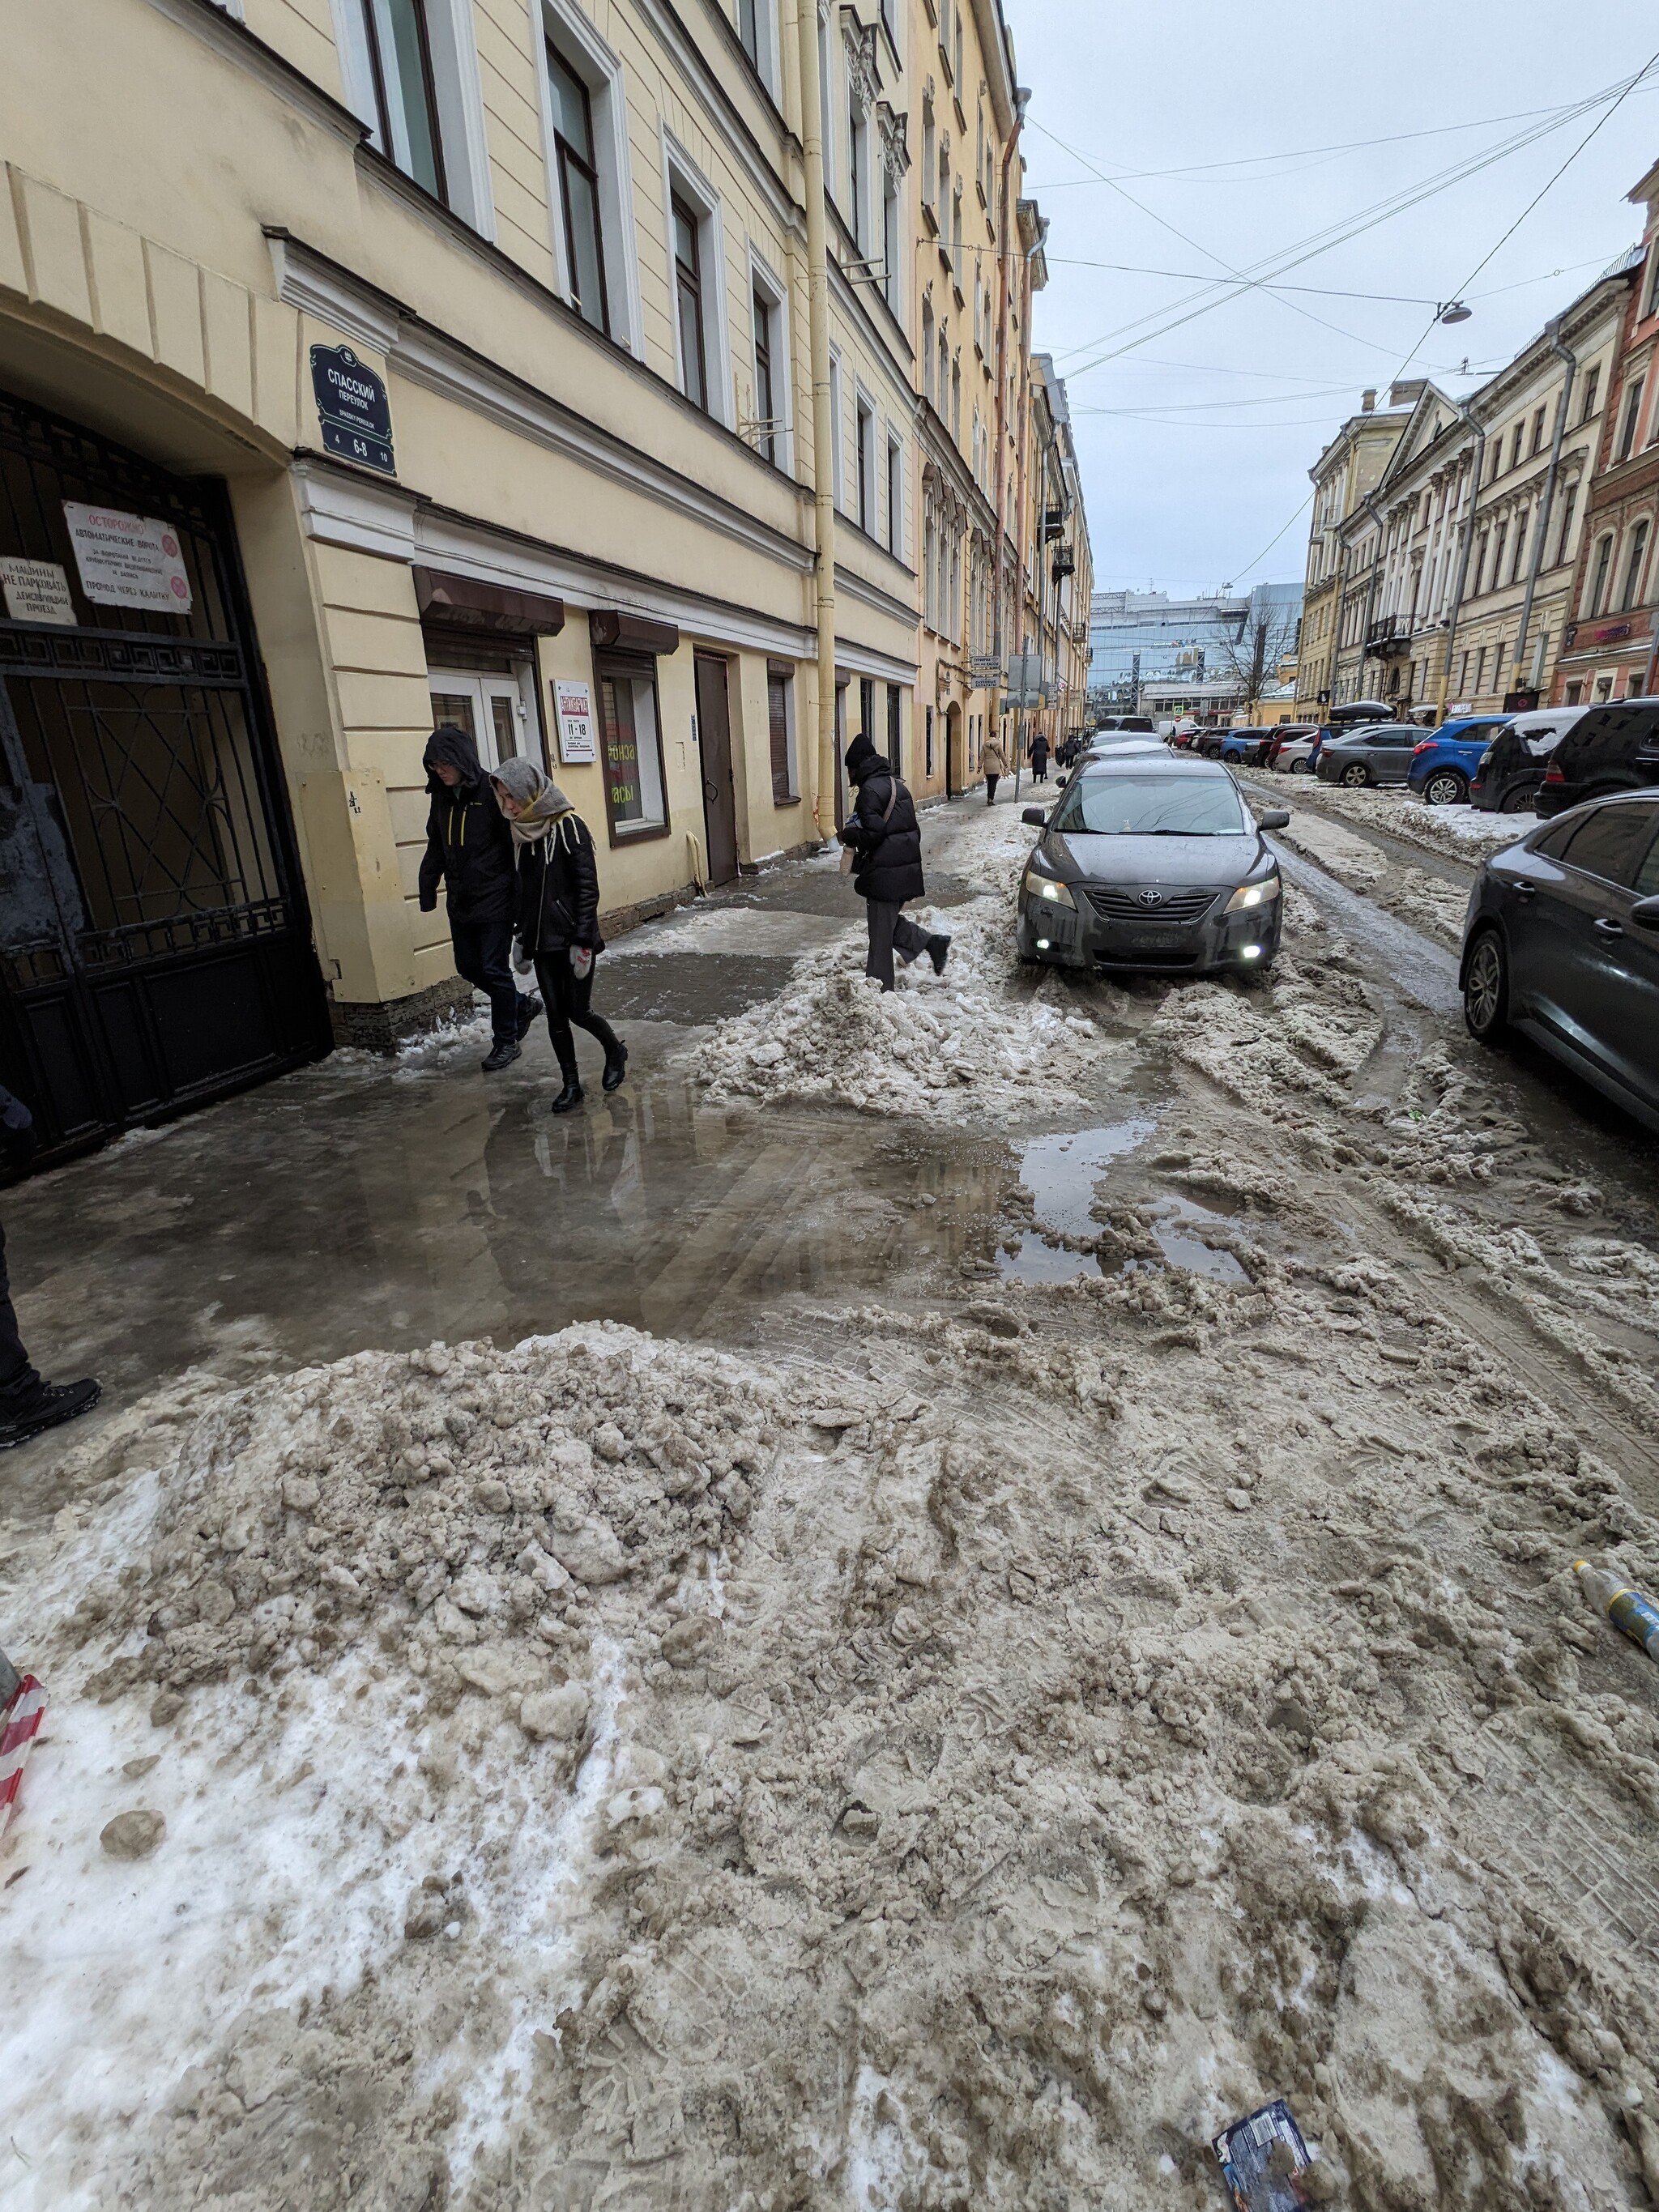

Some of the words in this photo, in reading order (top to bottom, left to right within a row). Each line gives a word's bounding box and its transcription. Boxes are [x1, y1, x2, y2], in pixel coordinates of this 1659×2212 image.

[328, 368, 375, 402] СПАССКИЙ
[339, 389, 369, 411] ПЕРЕУЛОК
[339, 409, 356, 421] SPASSKY
[335, 434, 340, 444] 4
[353, 438, 368, 457] 6-8
[380, 452, 388, 462] 10
[88, 514, 144, 535] ОСТОРОЖНО
[75, 528, 134, 547] АВТОМАТИЧЕСКИЕ
[138, 539, 160, 552] ВОРОТА
[8, 564, 55, 578] МАШИНЫ
[2, 573, 17, 586] НЕ
[18, 576, 66, 592] ПАРКОВАТЬ
[86, 580, 116, 593] ПРОХОД
[117, 586, 137, 596] ЧЕРЕЗ
[139, 589, 169, 601] КАЛИТКУ
[26, 603, 57, 615] ПРОЕЗД
[568, 723, 574, 735] 11
[578, 723, 586, 735] 18
